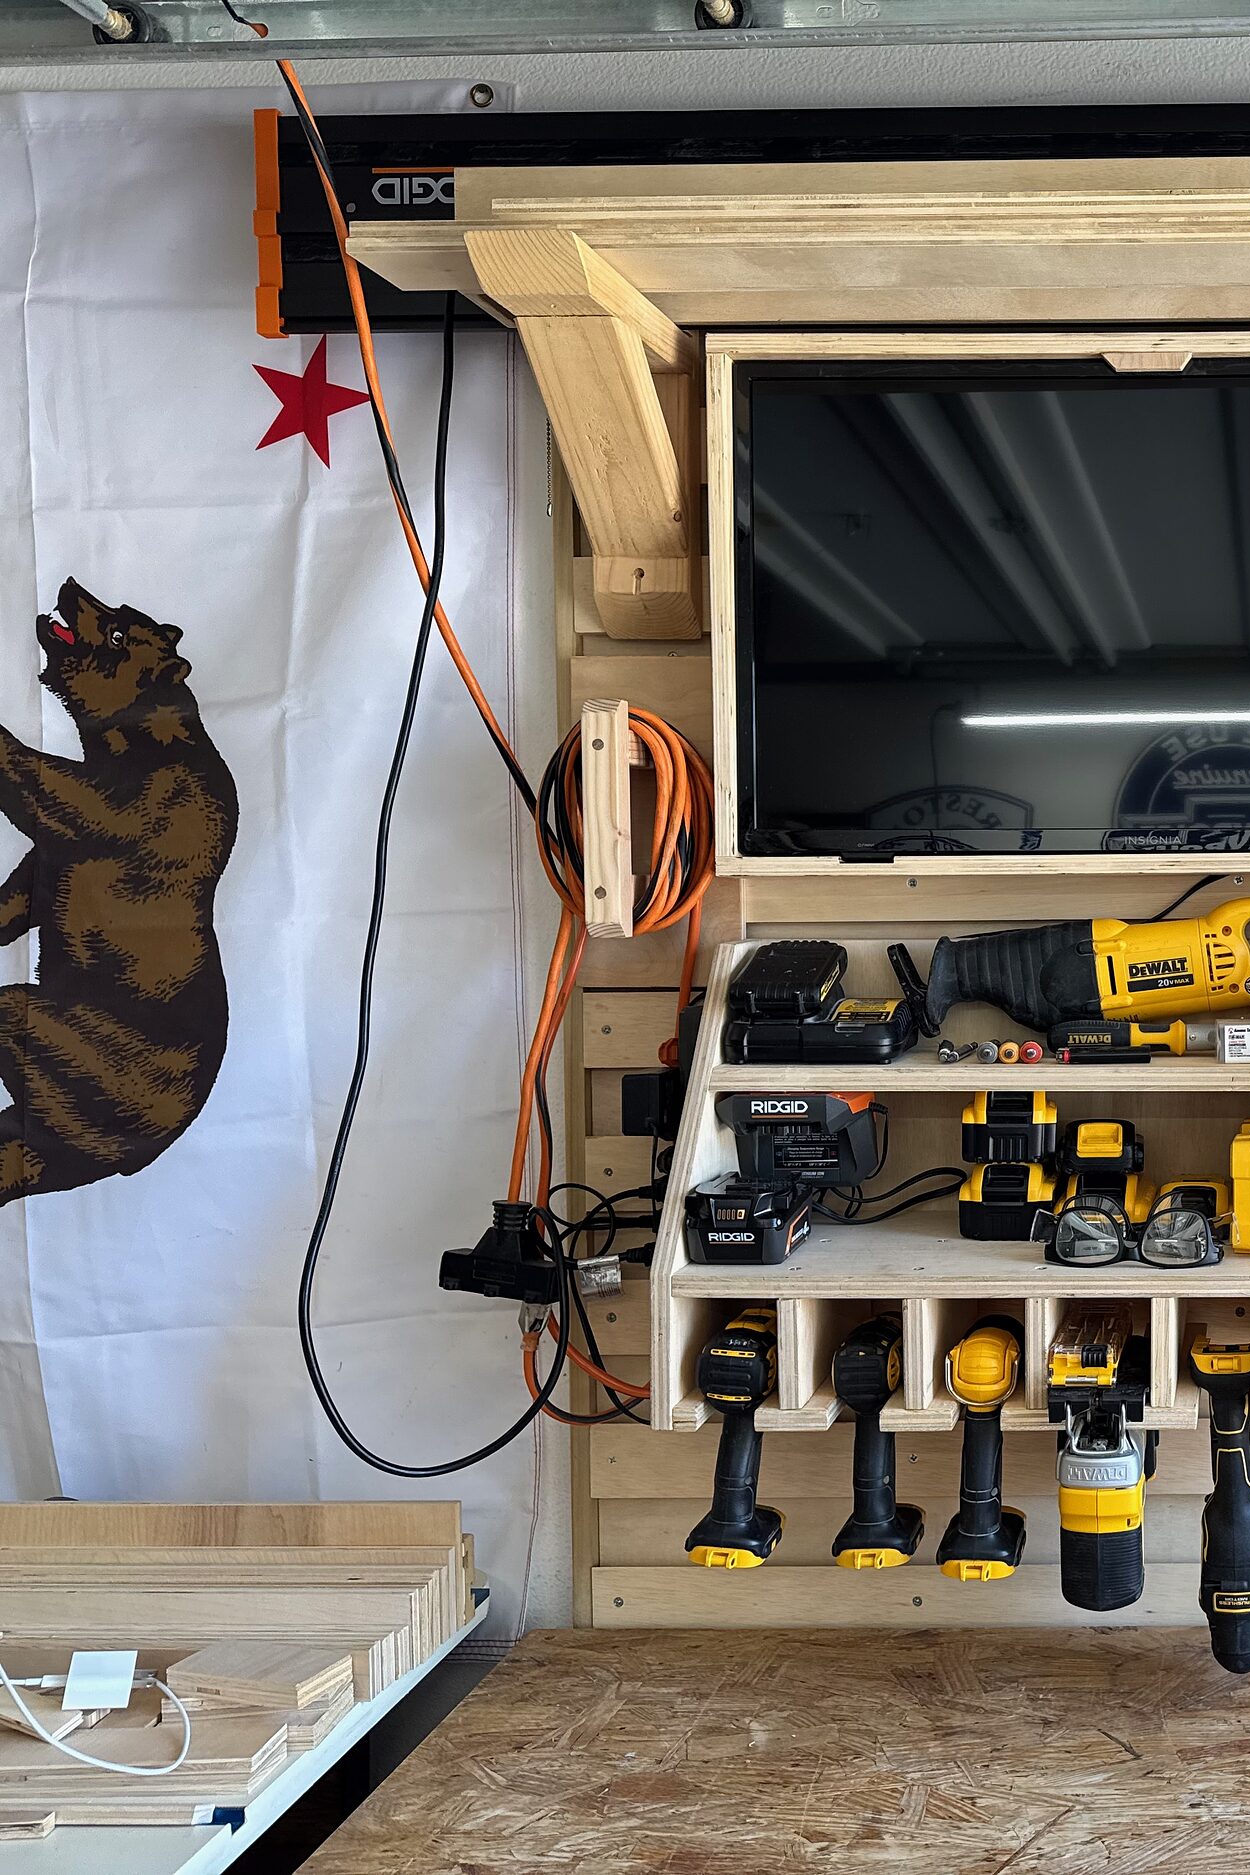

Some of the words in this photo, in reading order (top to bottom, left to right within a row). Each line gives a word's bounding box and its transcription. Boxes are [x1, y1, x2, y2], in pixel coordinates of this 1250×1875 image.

[371, 177, 455, 205] DGID
[1123, 835, 1182, 846] INSIGNIA
[1128, 958, 1189, 979] DEWALT
[1067, 1034, 1112, 1045] DEWALT
[750, 1100, 809, 1114] RIDGID
[707, 1232, 755, 1242] RIDGID
